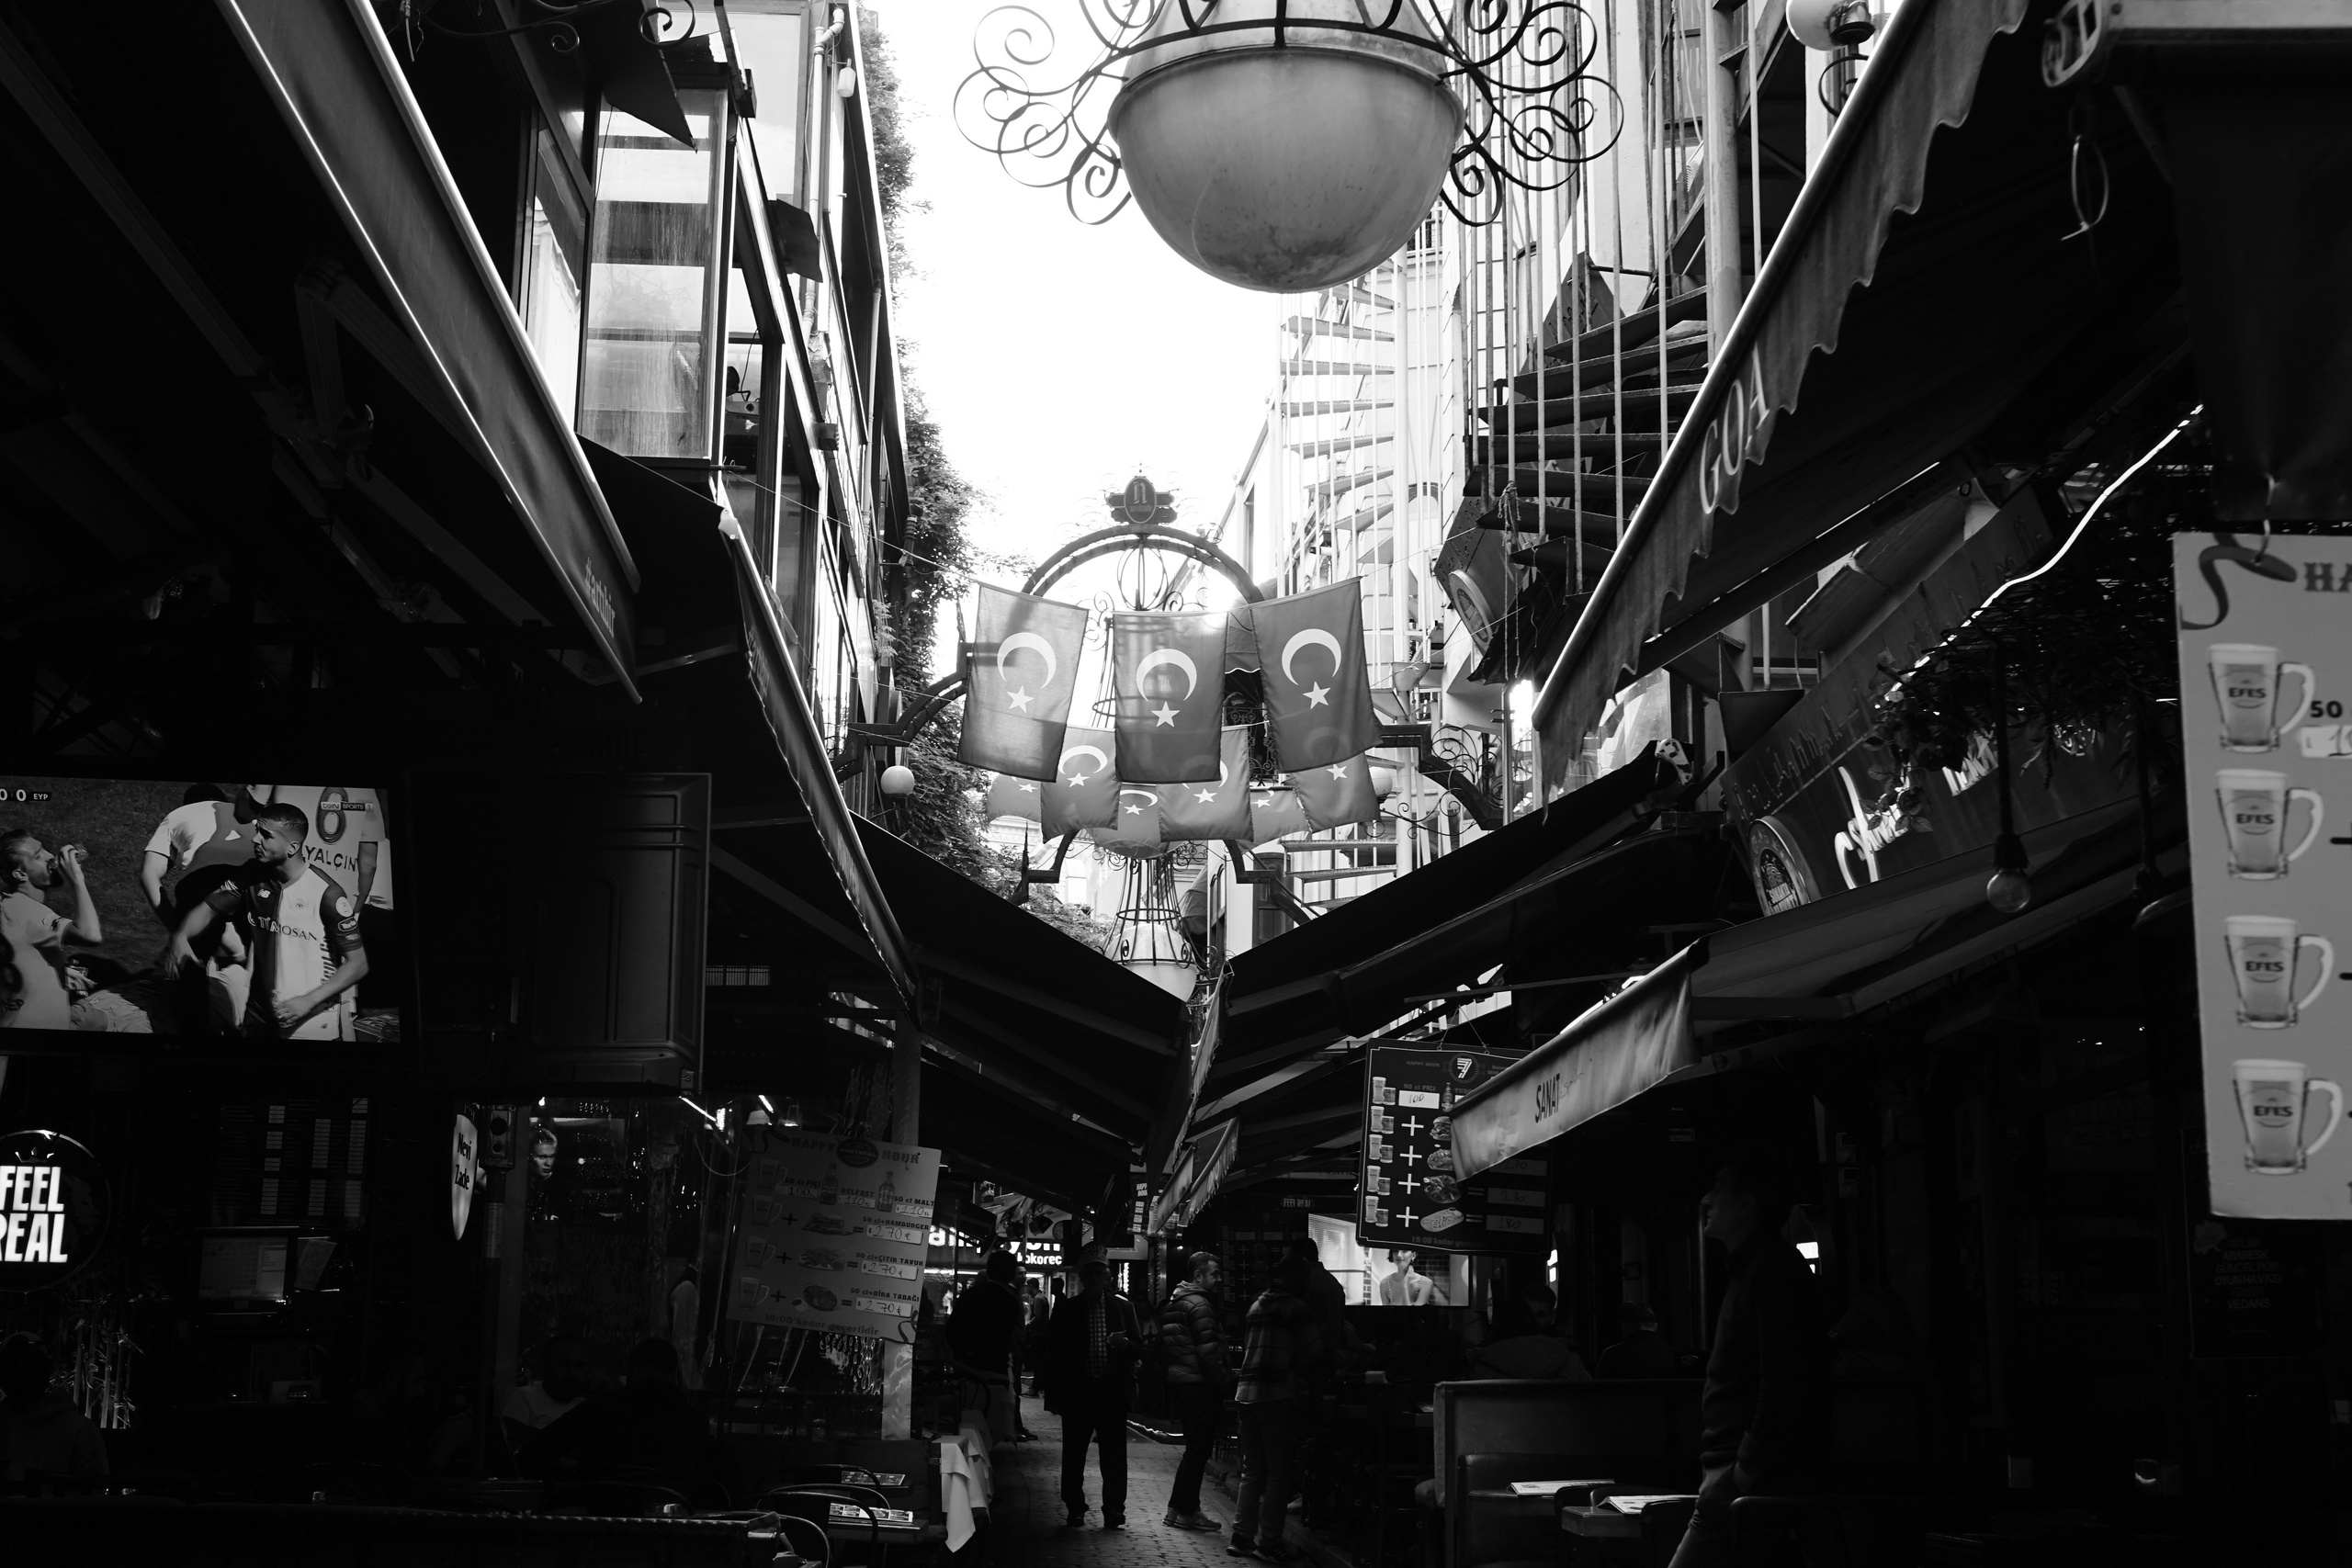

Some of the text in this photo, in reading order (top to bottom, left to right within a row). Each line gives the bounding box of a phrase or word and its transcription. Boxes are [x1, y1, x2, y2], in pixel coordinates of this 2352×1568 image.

[1699, 341, 1770, 514] GOA
[2229, 687, 2267, 698] EFES
[2310, 700, 2343, 719] 50
[2236, 813, 2275, 825] EFES
[2245, 961, 2284, 972] EFES
[1408, 1093, 1425, 1104] 100
[1535, 1073, 1560, 1123] SANAT
[2254, 1105, 2293, 1117] EFES
[458, 1133, 472, 1161] Nevi
[791, 1136, 920, 1165] HAPPY HOUR
[455, 1164, 469, 1190] Zade
[841, 1187, 876, 1198] BELFAST
[1501, 1190, 1525, 1202] 270
[914, 1197, 935, 1207] MALT
[2222, 1250, 2269, 1261] ARABESK
[899, 1257, 924, 1267] TAVUK
[2257, 1261, 2279, 1272] POP
[2214, 1273, 2283, 1286] OYUN HAVASI
[893, 1293, 920, 1303] TABAĞI
[2241, 1298, 2271, 1309] DANS
[828, 1323, 879, 1337] geçerlidir
